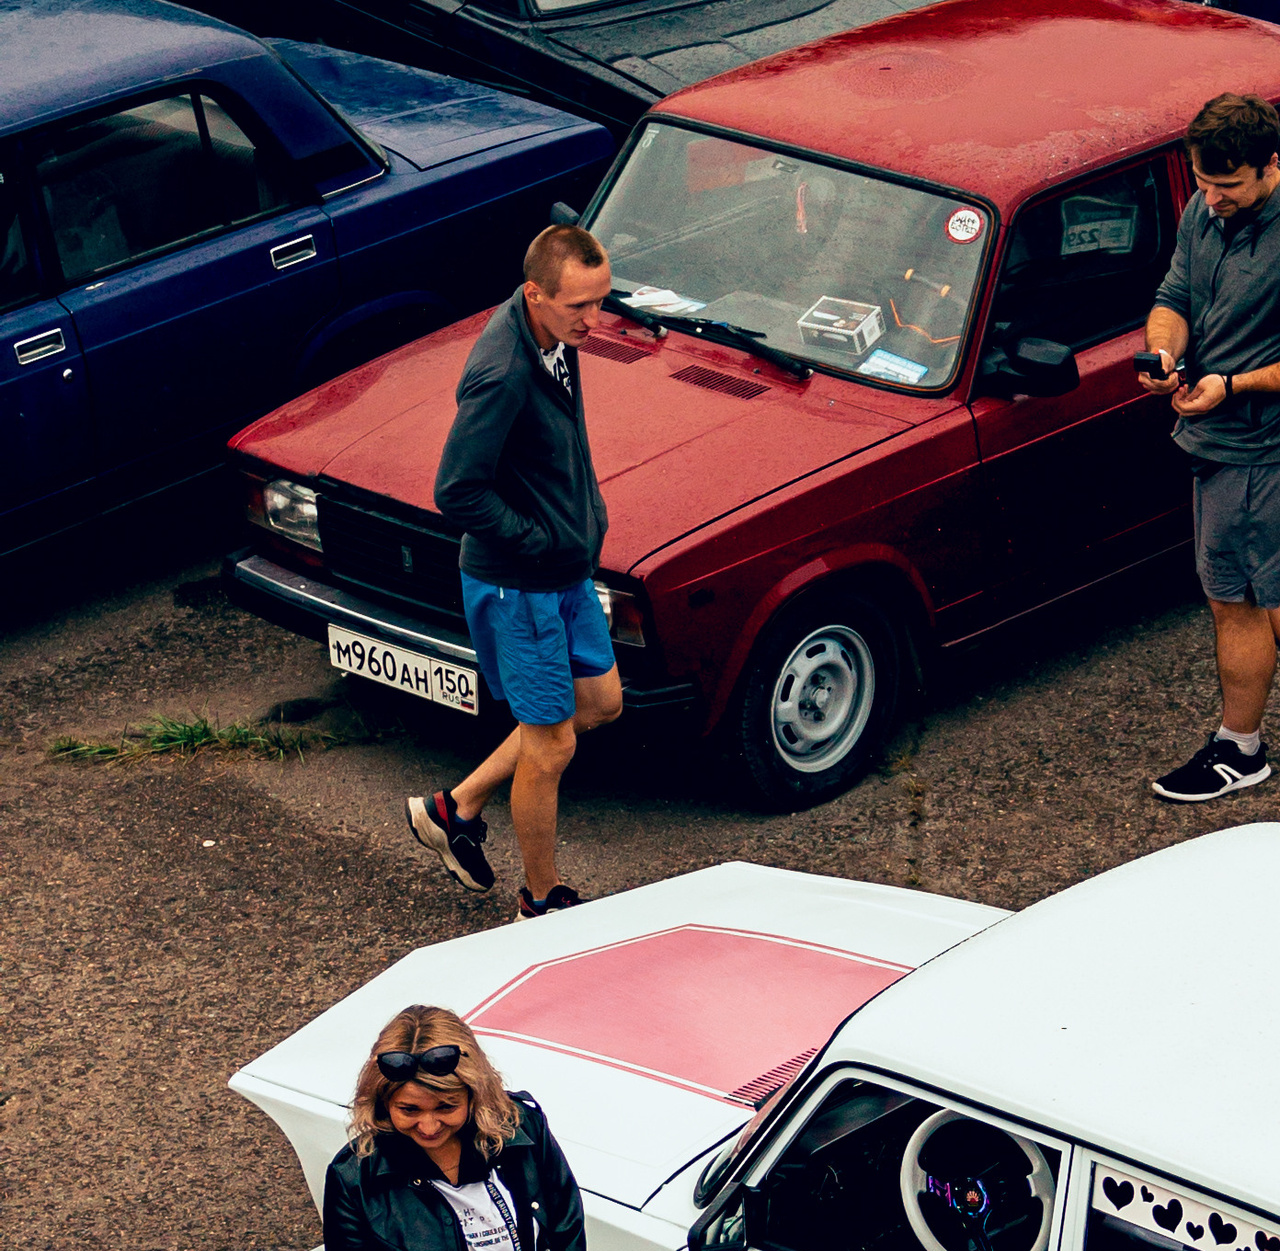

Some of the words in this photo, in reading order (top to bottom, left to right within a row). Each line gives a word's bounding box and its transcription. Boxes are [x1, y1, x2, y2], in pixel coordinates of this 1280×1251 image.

[336, 640, 429, 694] М960АН
[434, 666, 469, 698] 150
[442, 691, 460, 705] RUS
